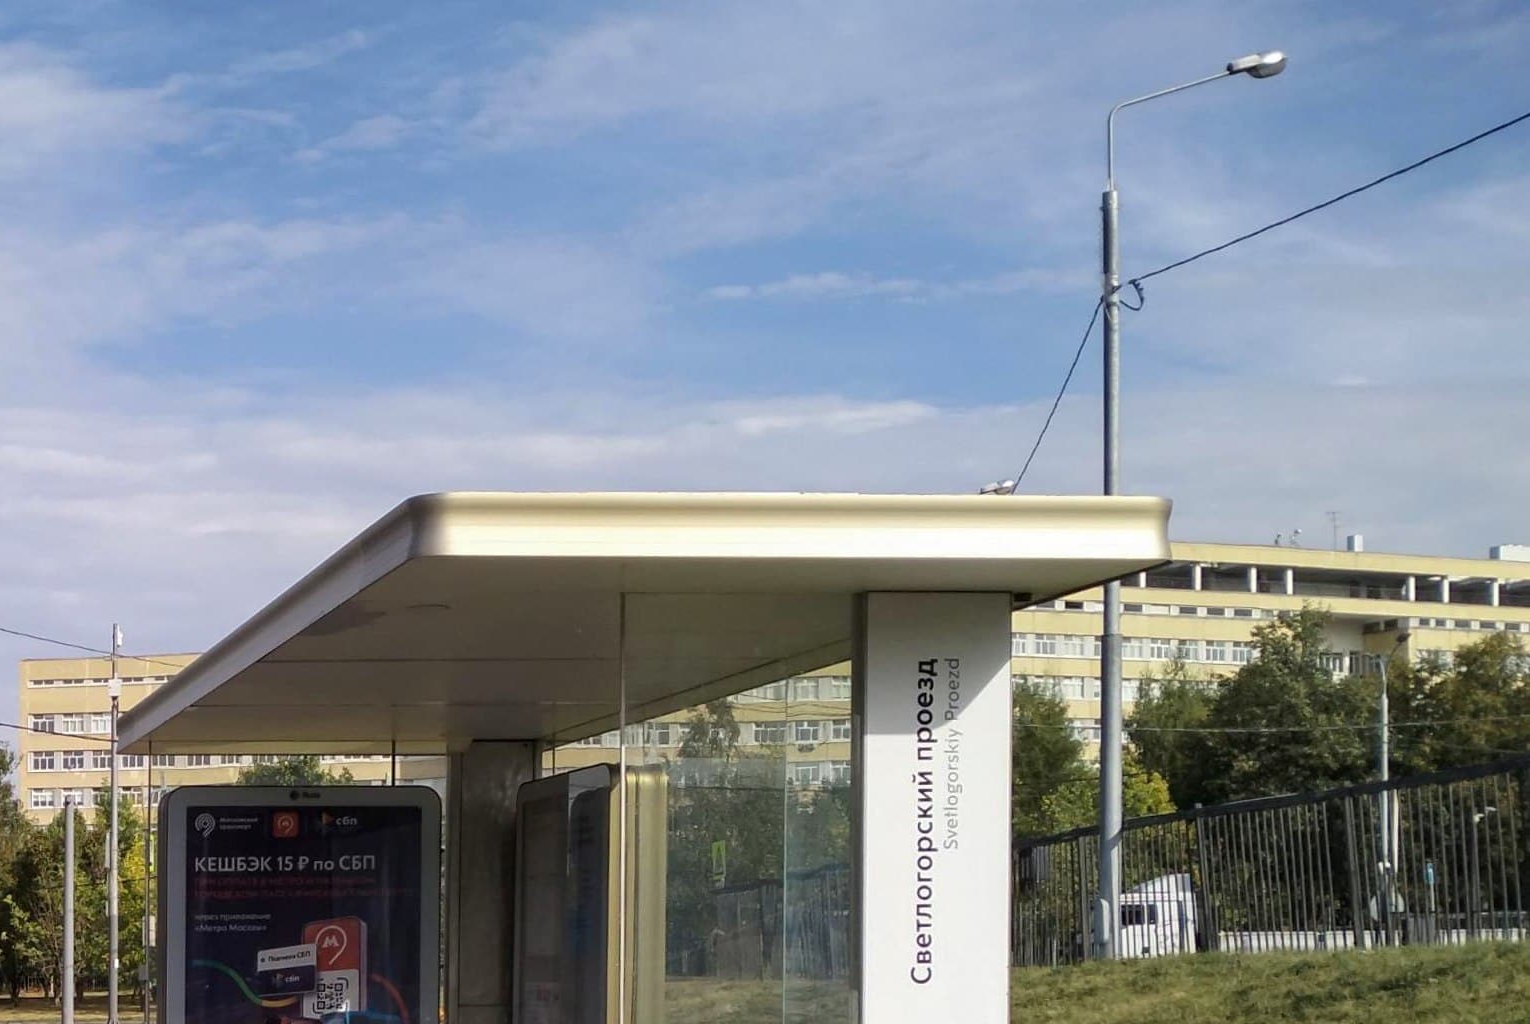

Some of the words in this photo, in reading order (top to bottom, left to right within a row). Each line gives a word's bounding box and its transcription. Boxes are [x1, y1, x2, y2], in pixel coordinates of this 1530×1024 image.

[917, 658, 938, 760] проезд
[944, 658, 961, 721] Proezd
[943, 728, 964, 849] Svetlogorskiy
[194, 856, 272, 872] КЕШБЭК
[277, 856, 293, 871] 15
[313, 860, 335, 871] по
[339, 855, 376, 871] СБП
[911, 770, 938, 984] Светлогорский
